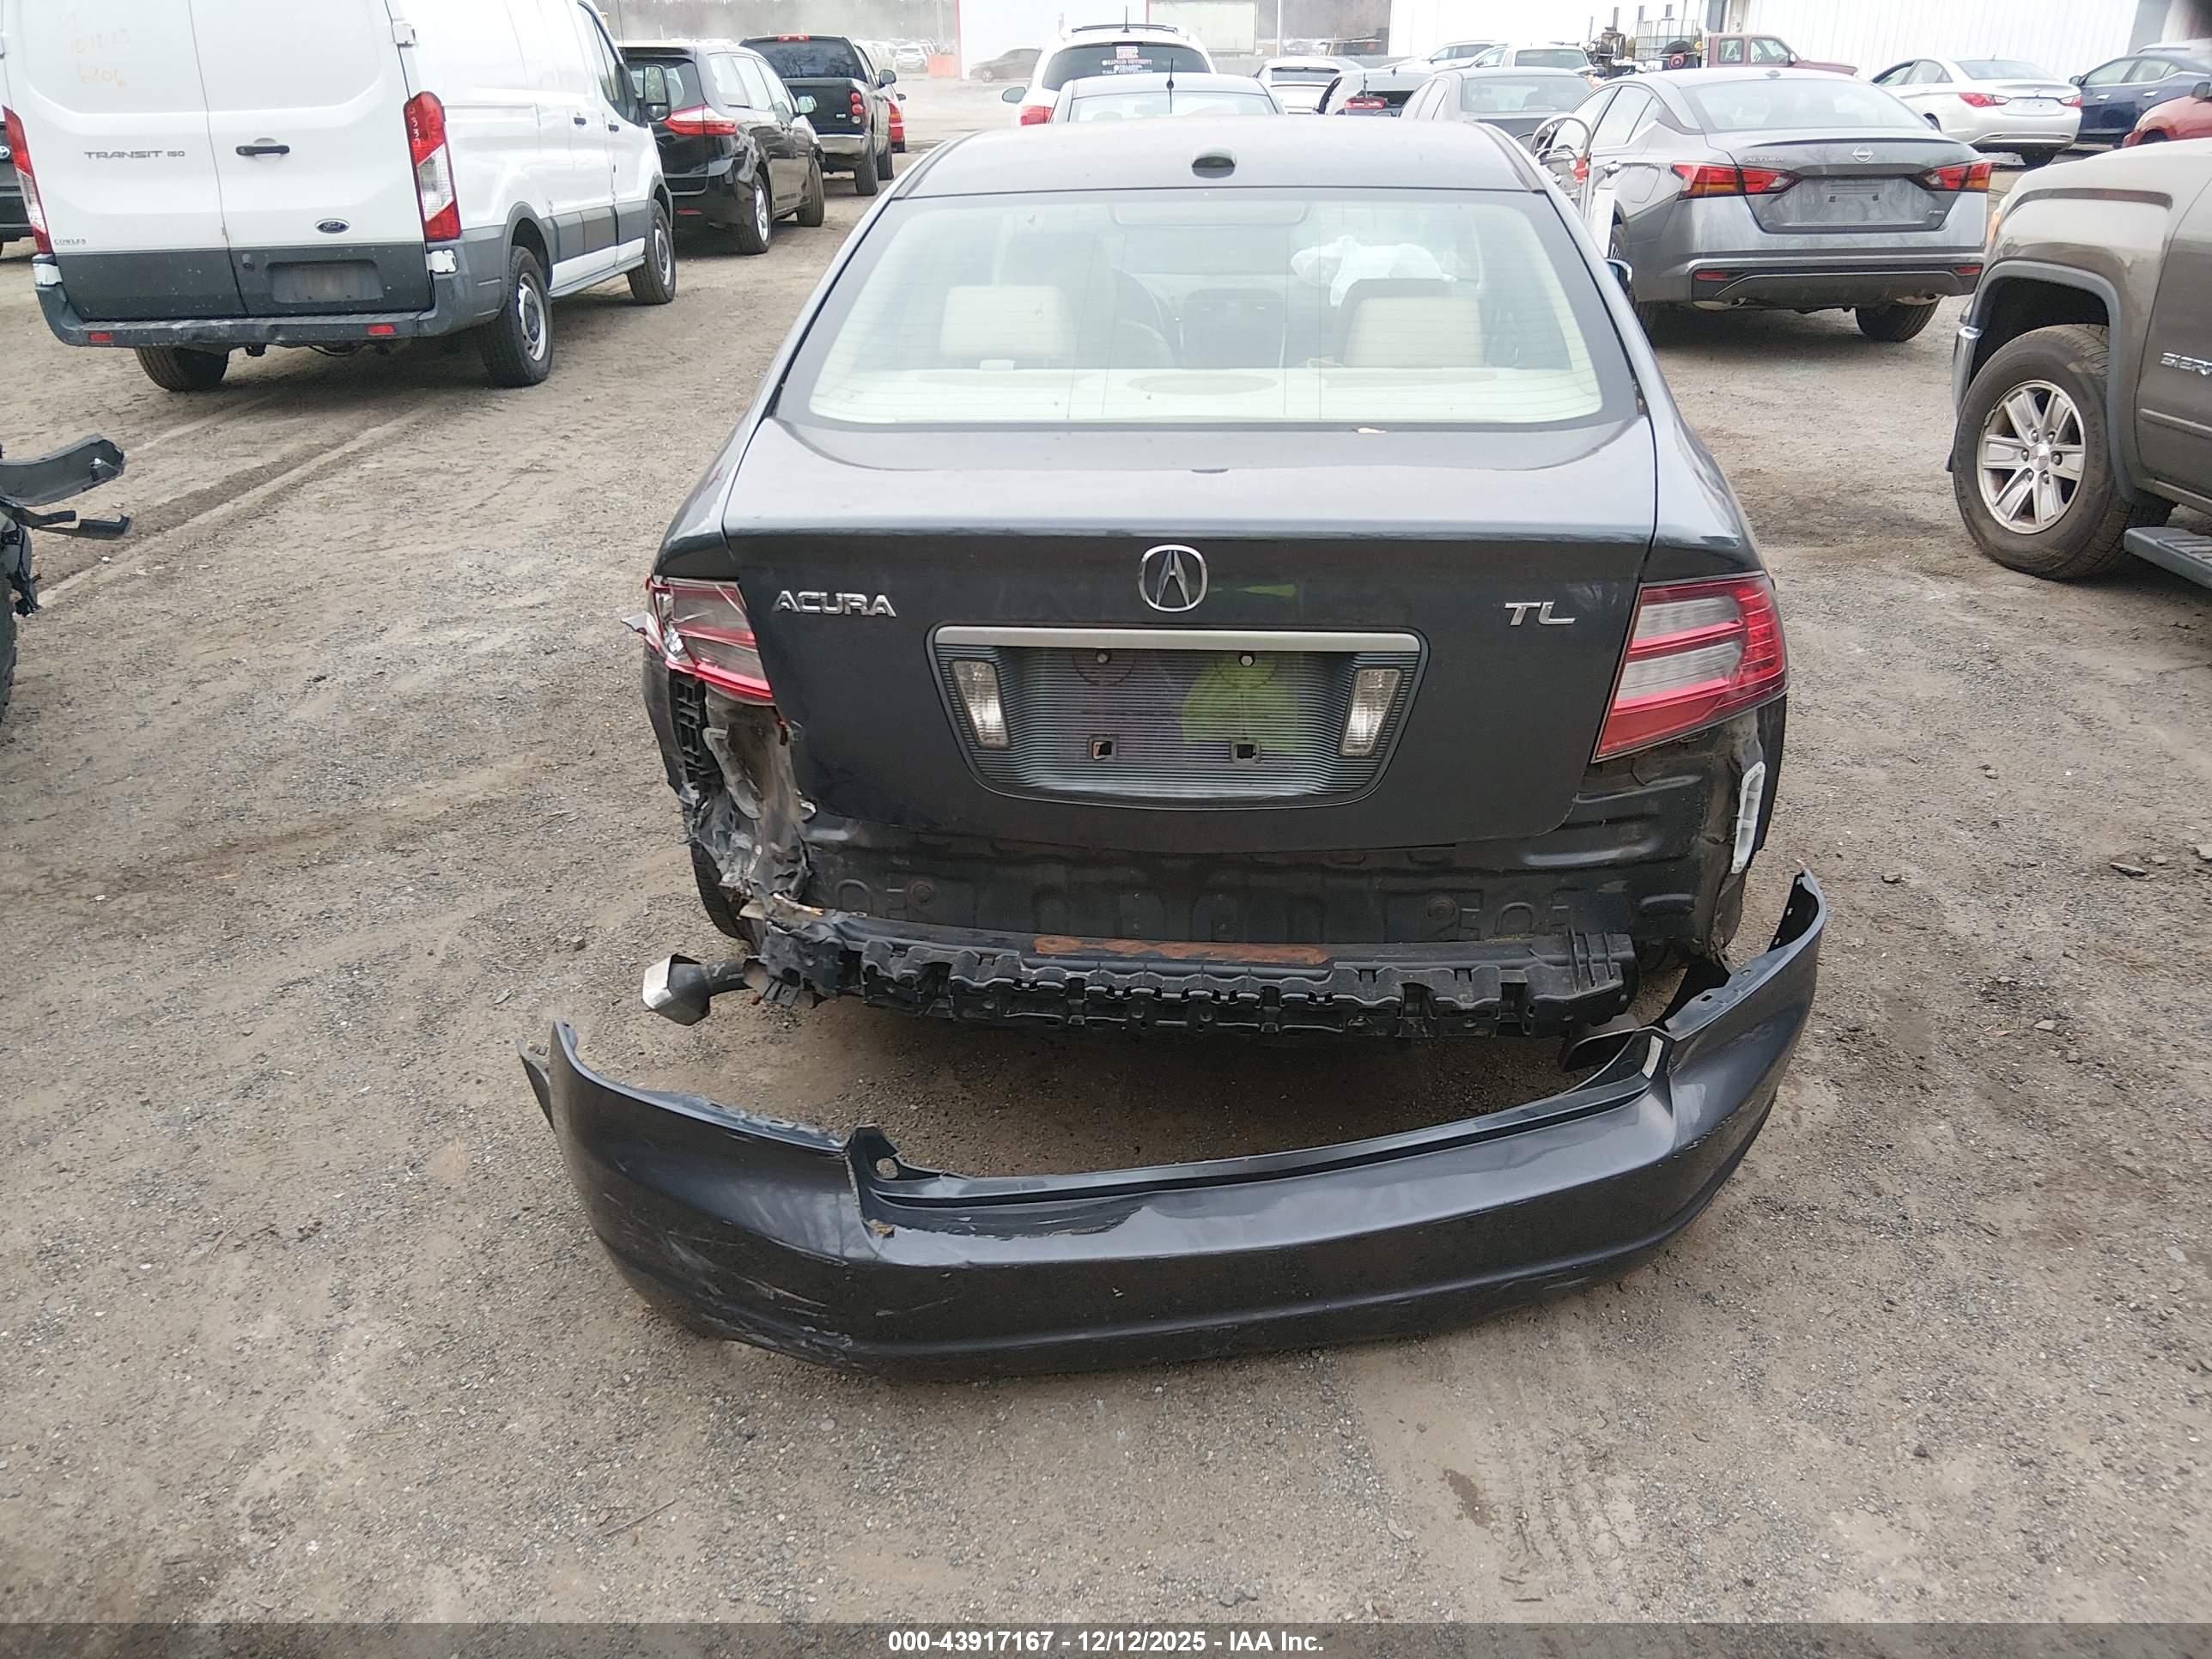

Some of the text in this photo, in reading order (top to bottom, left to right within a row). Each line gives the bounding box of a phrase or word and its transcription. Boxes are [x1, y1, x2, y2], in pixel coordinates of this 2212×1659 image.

[83, 150, 163, 160] TRANSIT
[773, 590, 897, 617] ACURA
[1504, 601, 1576, 626] TL
